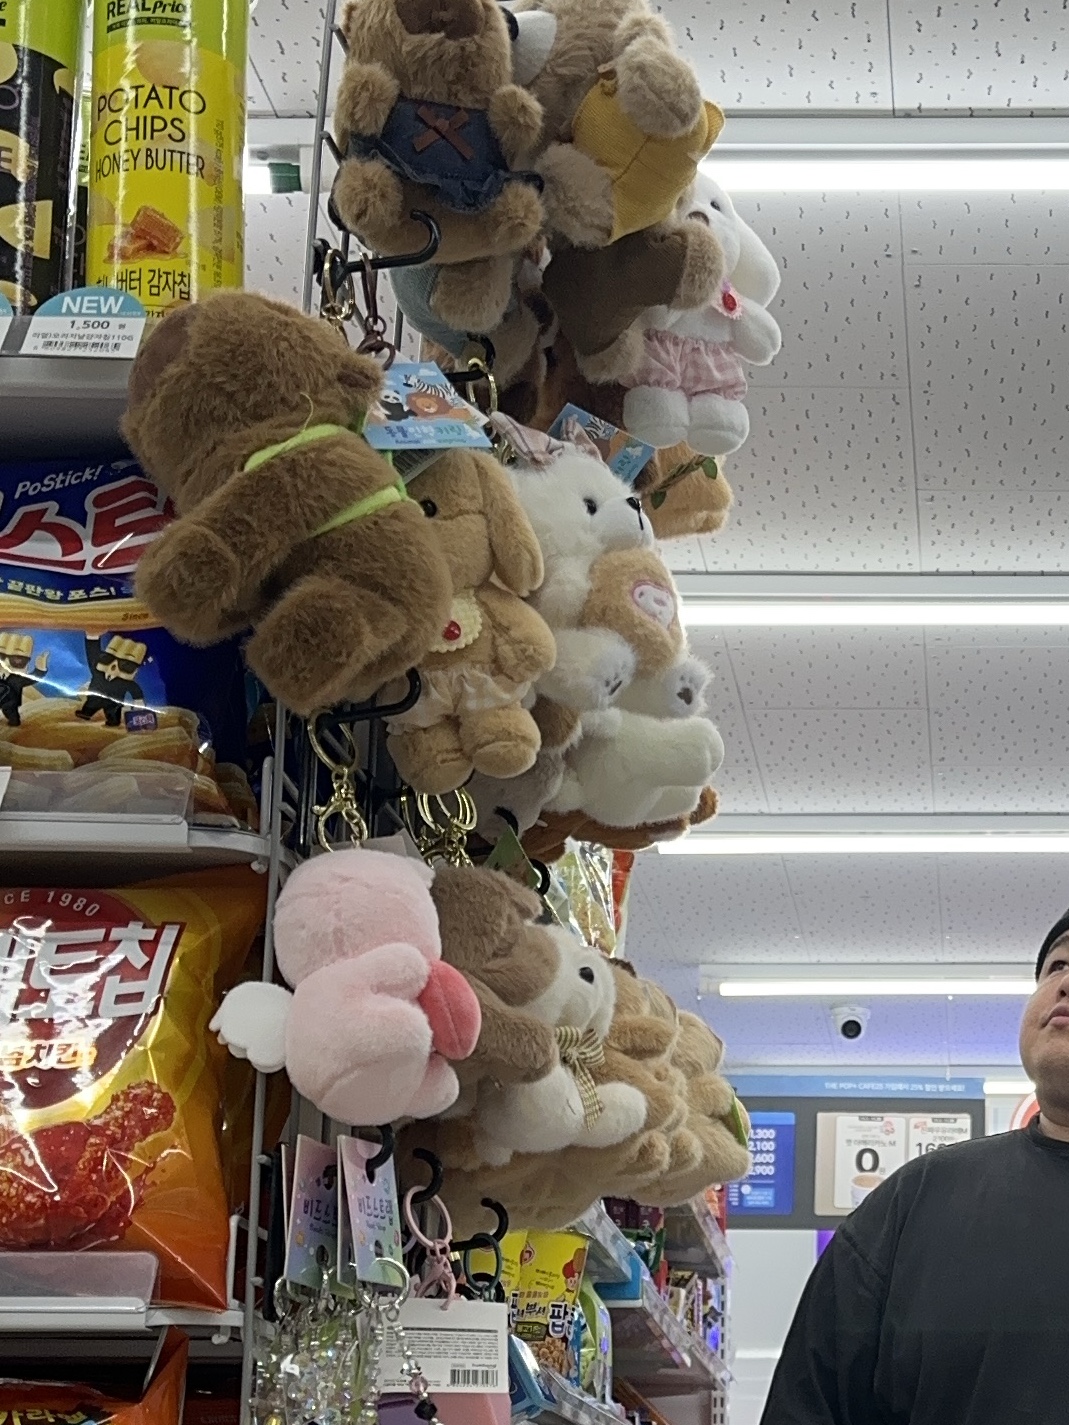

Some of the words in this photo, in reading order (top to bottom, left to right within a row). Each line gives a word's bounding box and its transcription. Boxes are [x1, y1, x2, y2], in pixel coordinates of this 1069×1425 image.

[98, 83, 206, 121] POTATO
[104, 115, 186, 146] CHIPS
[95, 149, 143, 183] HONEY
[145, 147, 205, 180] BUTTER
[147, 269, 191, 300] 감자칩
[61, 296, 125, 314] NEW
[14, 464, 104, 499] PoStick!
[47, 890, 100, 917] 1980
[855, 1147, 880, 1173] 0
